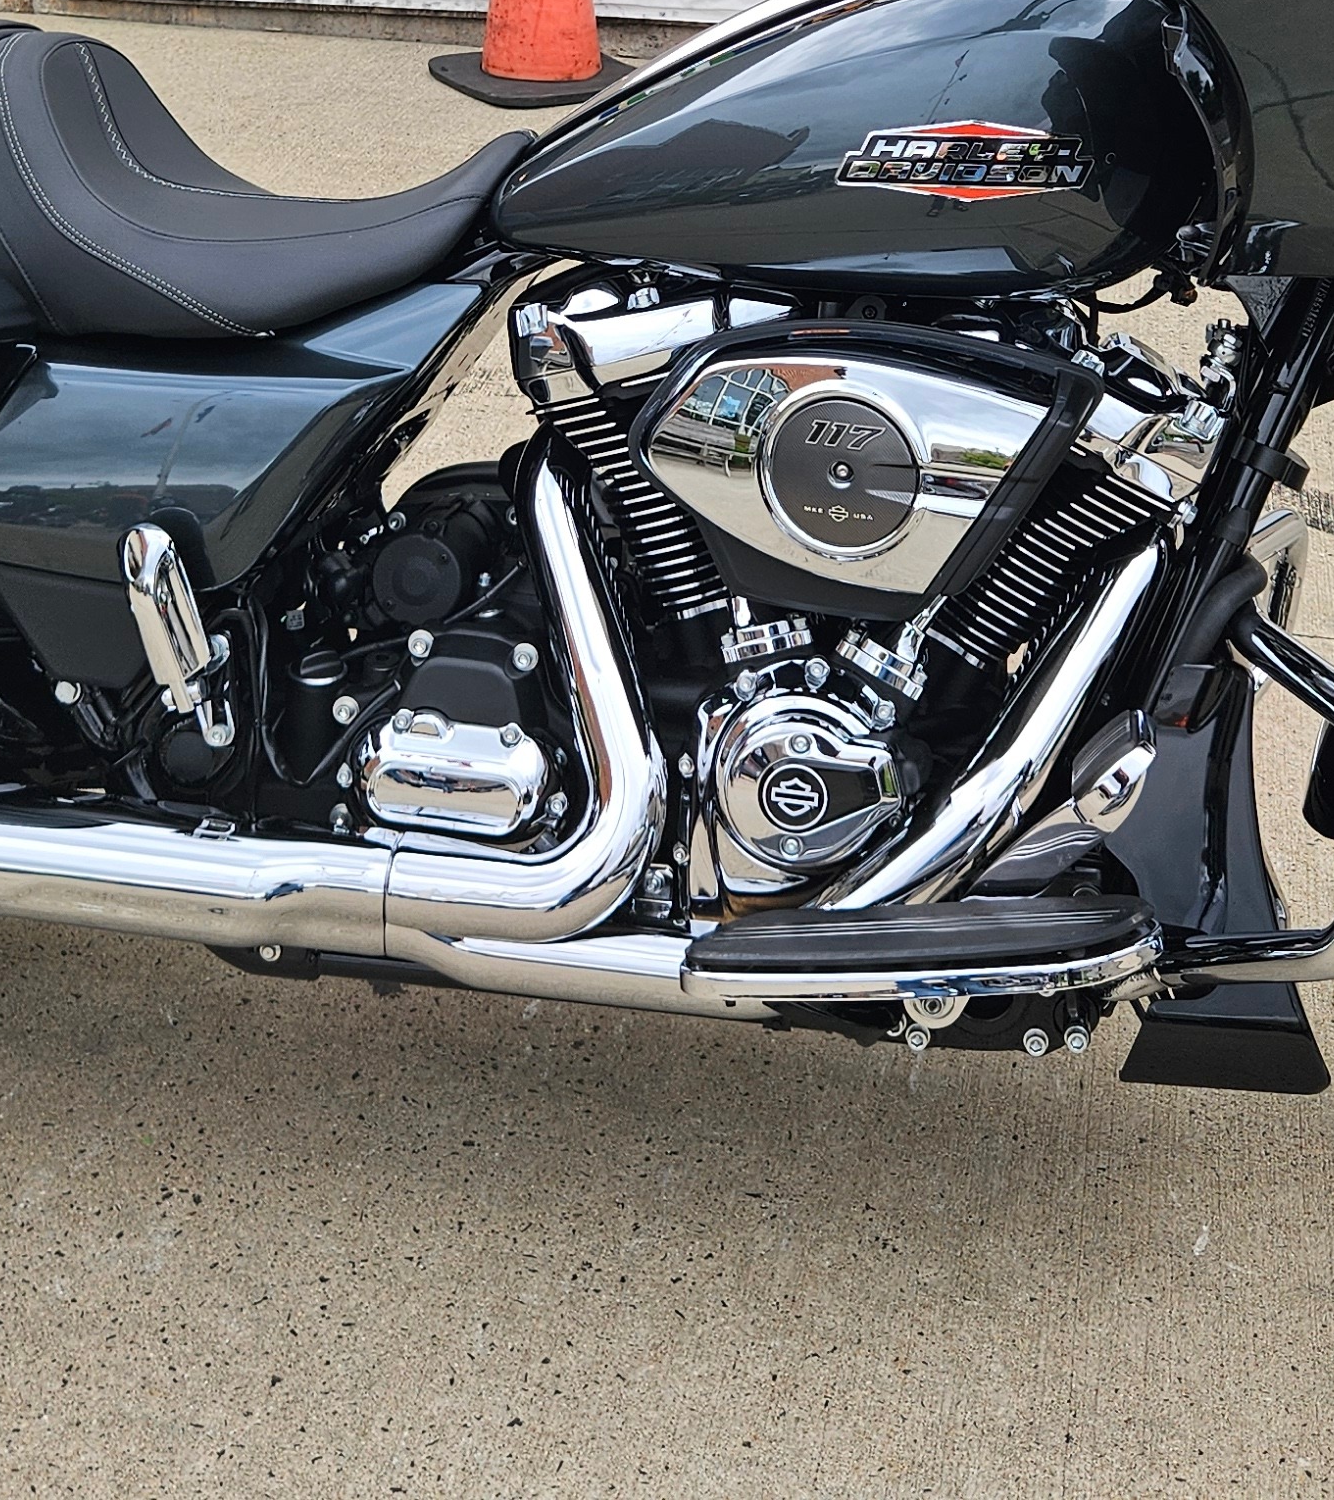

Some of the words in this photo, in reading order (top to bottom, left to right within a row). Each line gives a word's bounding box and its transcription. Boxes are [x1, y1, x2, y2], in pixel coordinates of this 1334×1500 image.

[870, 138, 1071, 162] HARLEY-
[845, 160, 1084, 184] DAVIDSON
[804, 419, 887, 451] 117
[803, 505, 824, 514] MKE
[853, 513, 874, 521] USA
